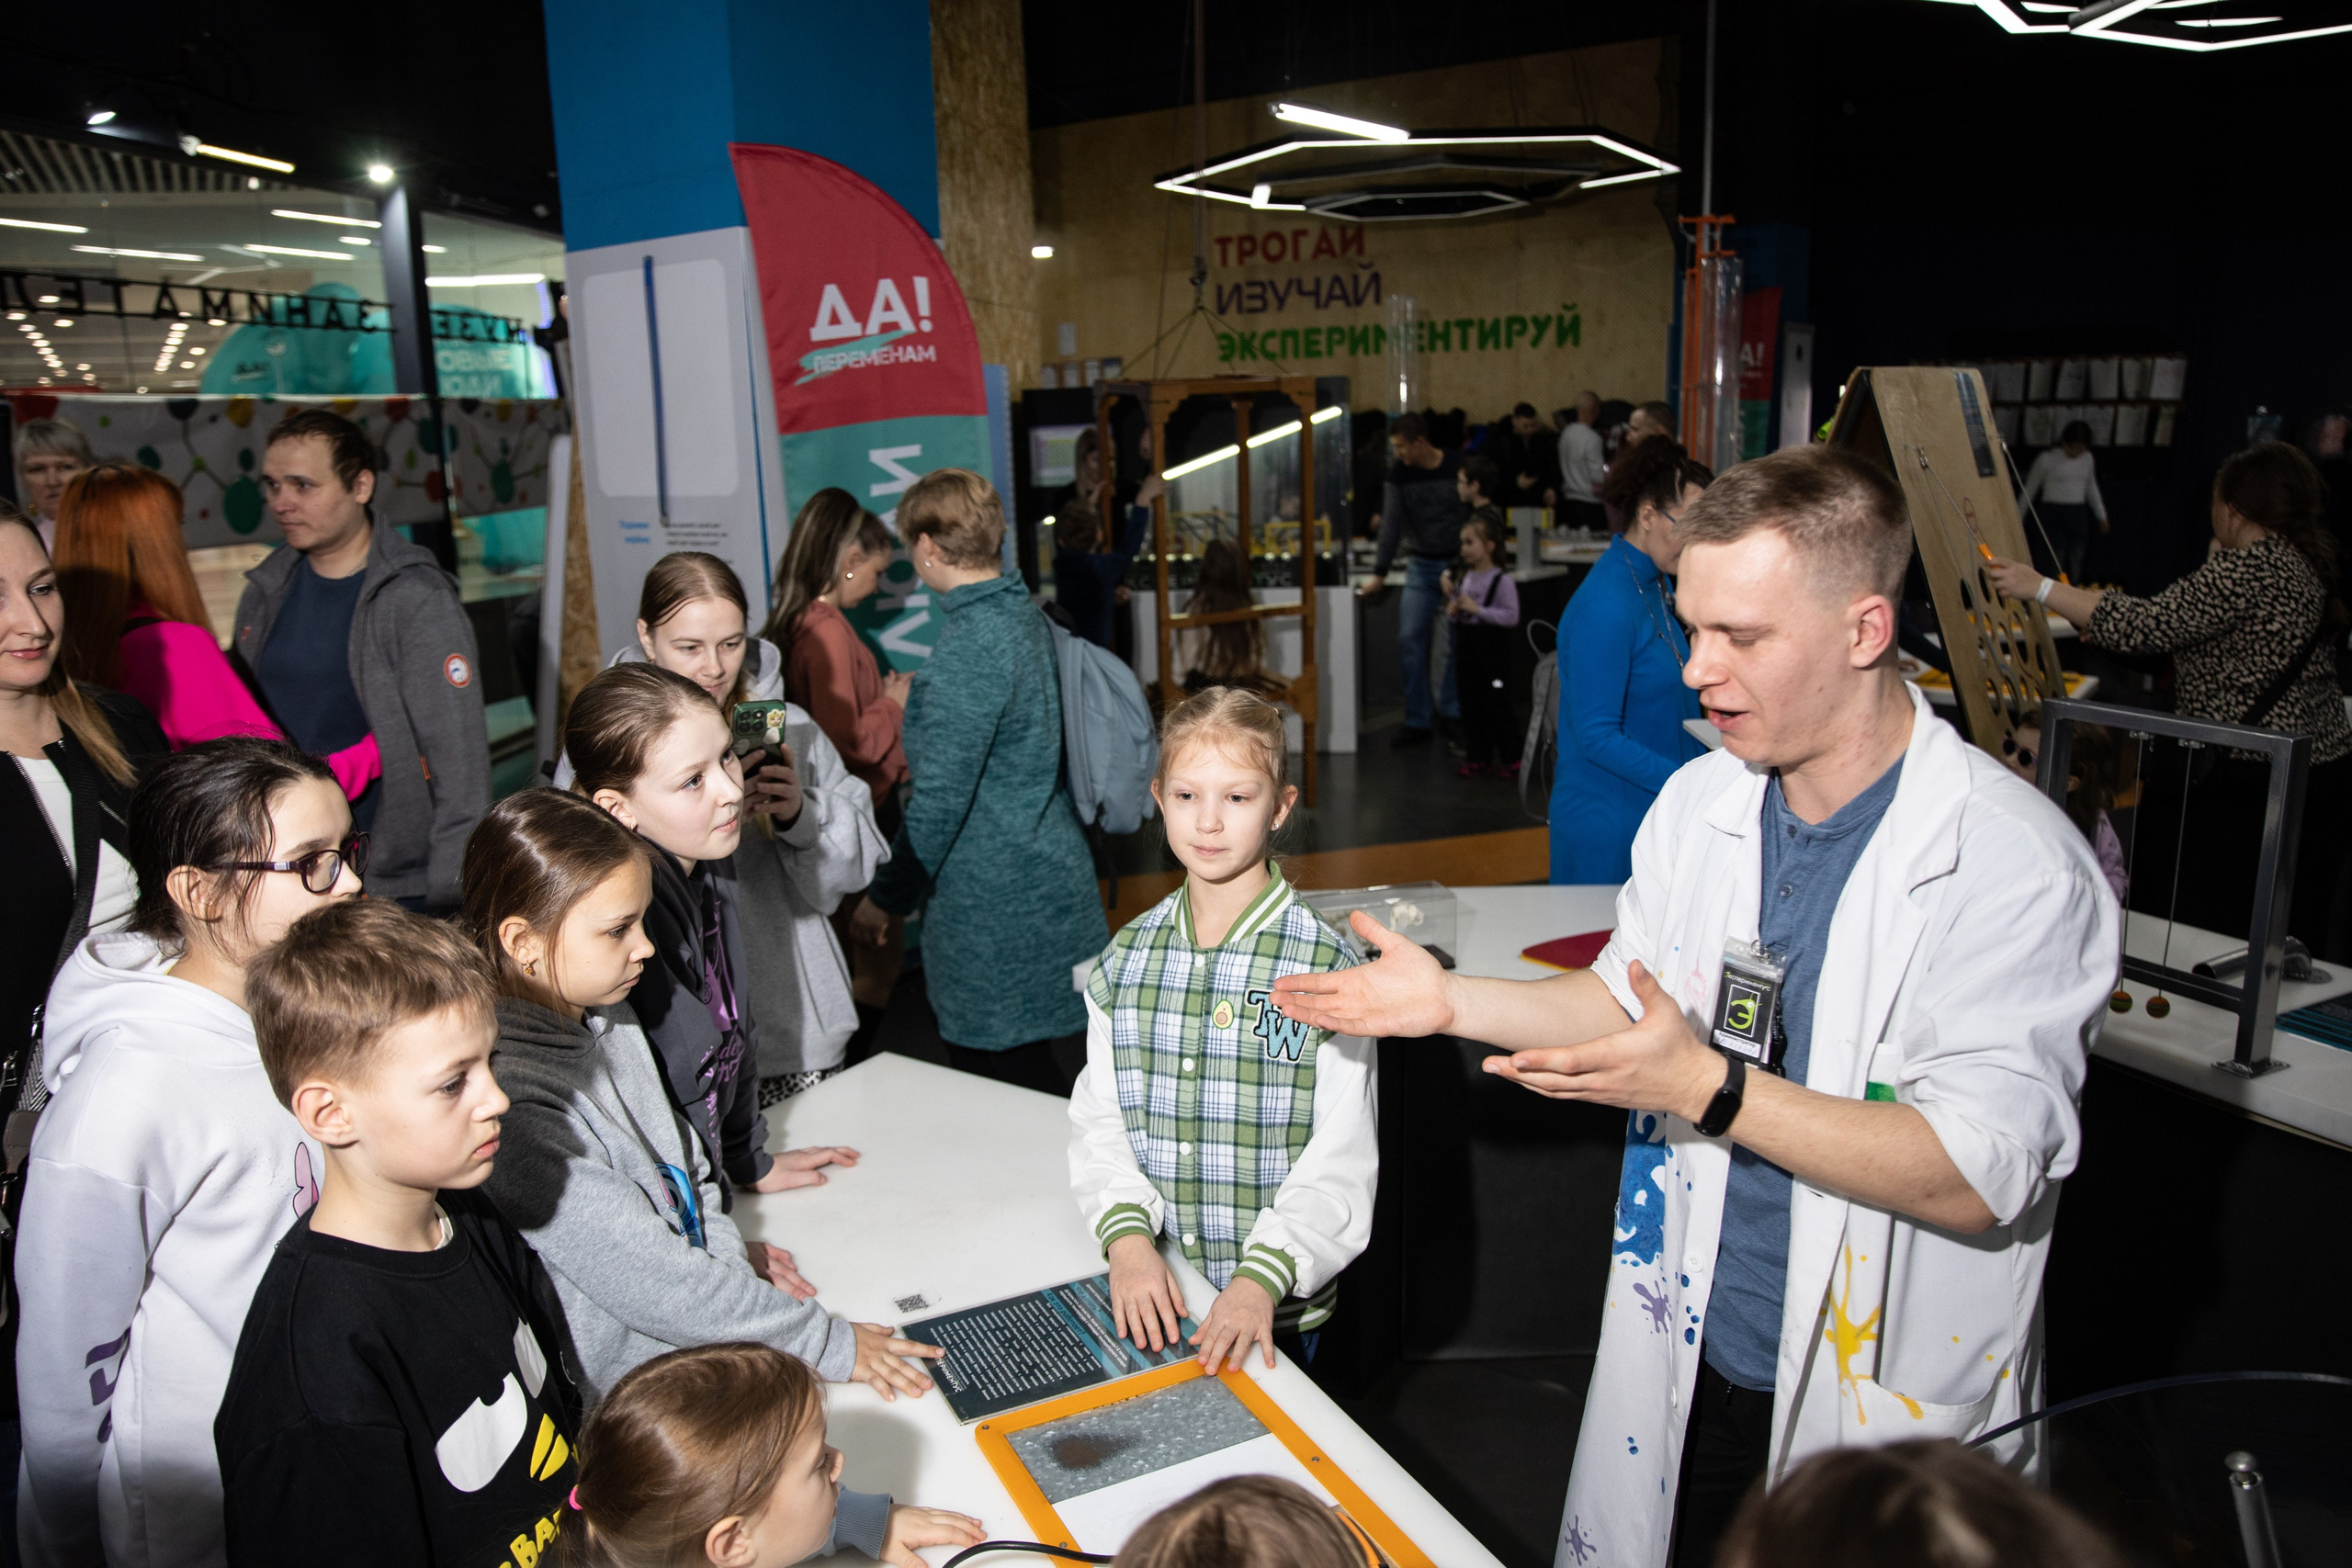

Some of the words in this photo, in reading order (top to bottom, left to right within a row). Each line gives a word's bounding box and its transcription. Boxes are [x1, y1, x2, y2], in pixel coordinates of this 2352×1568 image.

[809, 276, 933, 342] ДА!
[1216, 262, 1382, 316] ИЗУЧАЙ
[812, 344, 937, 373] ПЕРЕМЕНАМ
[934, 1358, 964, 1393] ПЕРИМЕНТУС
